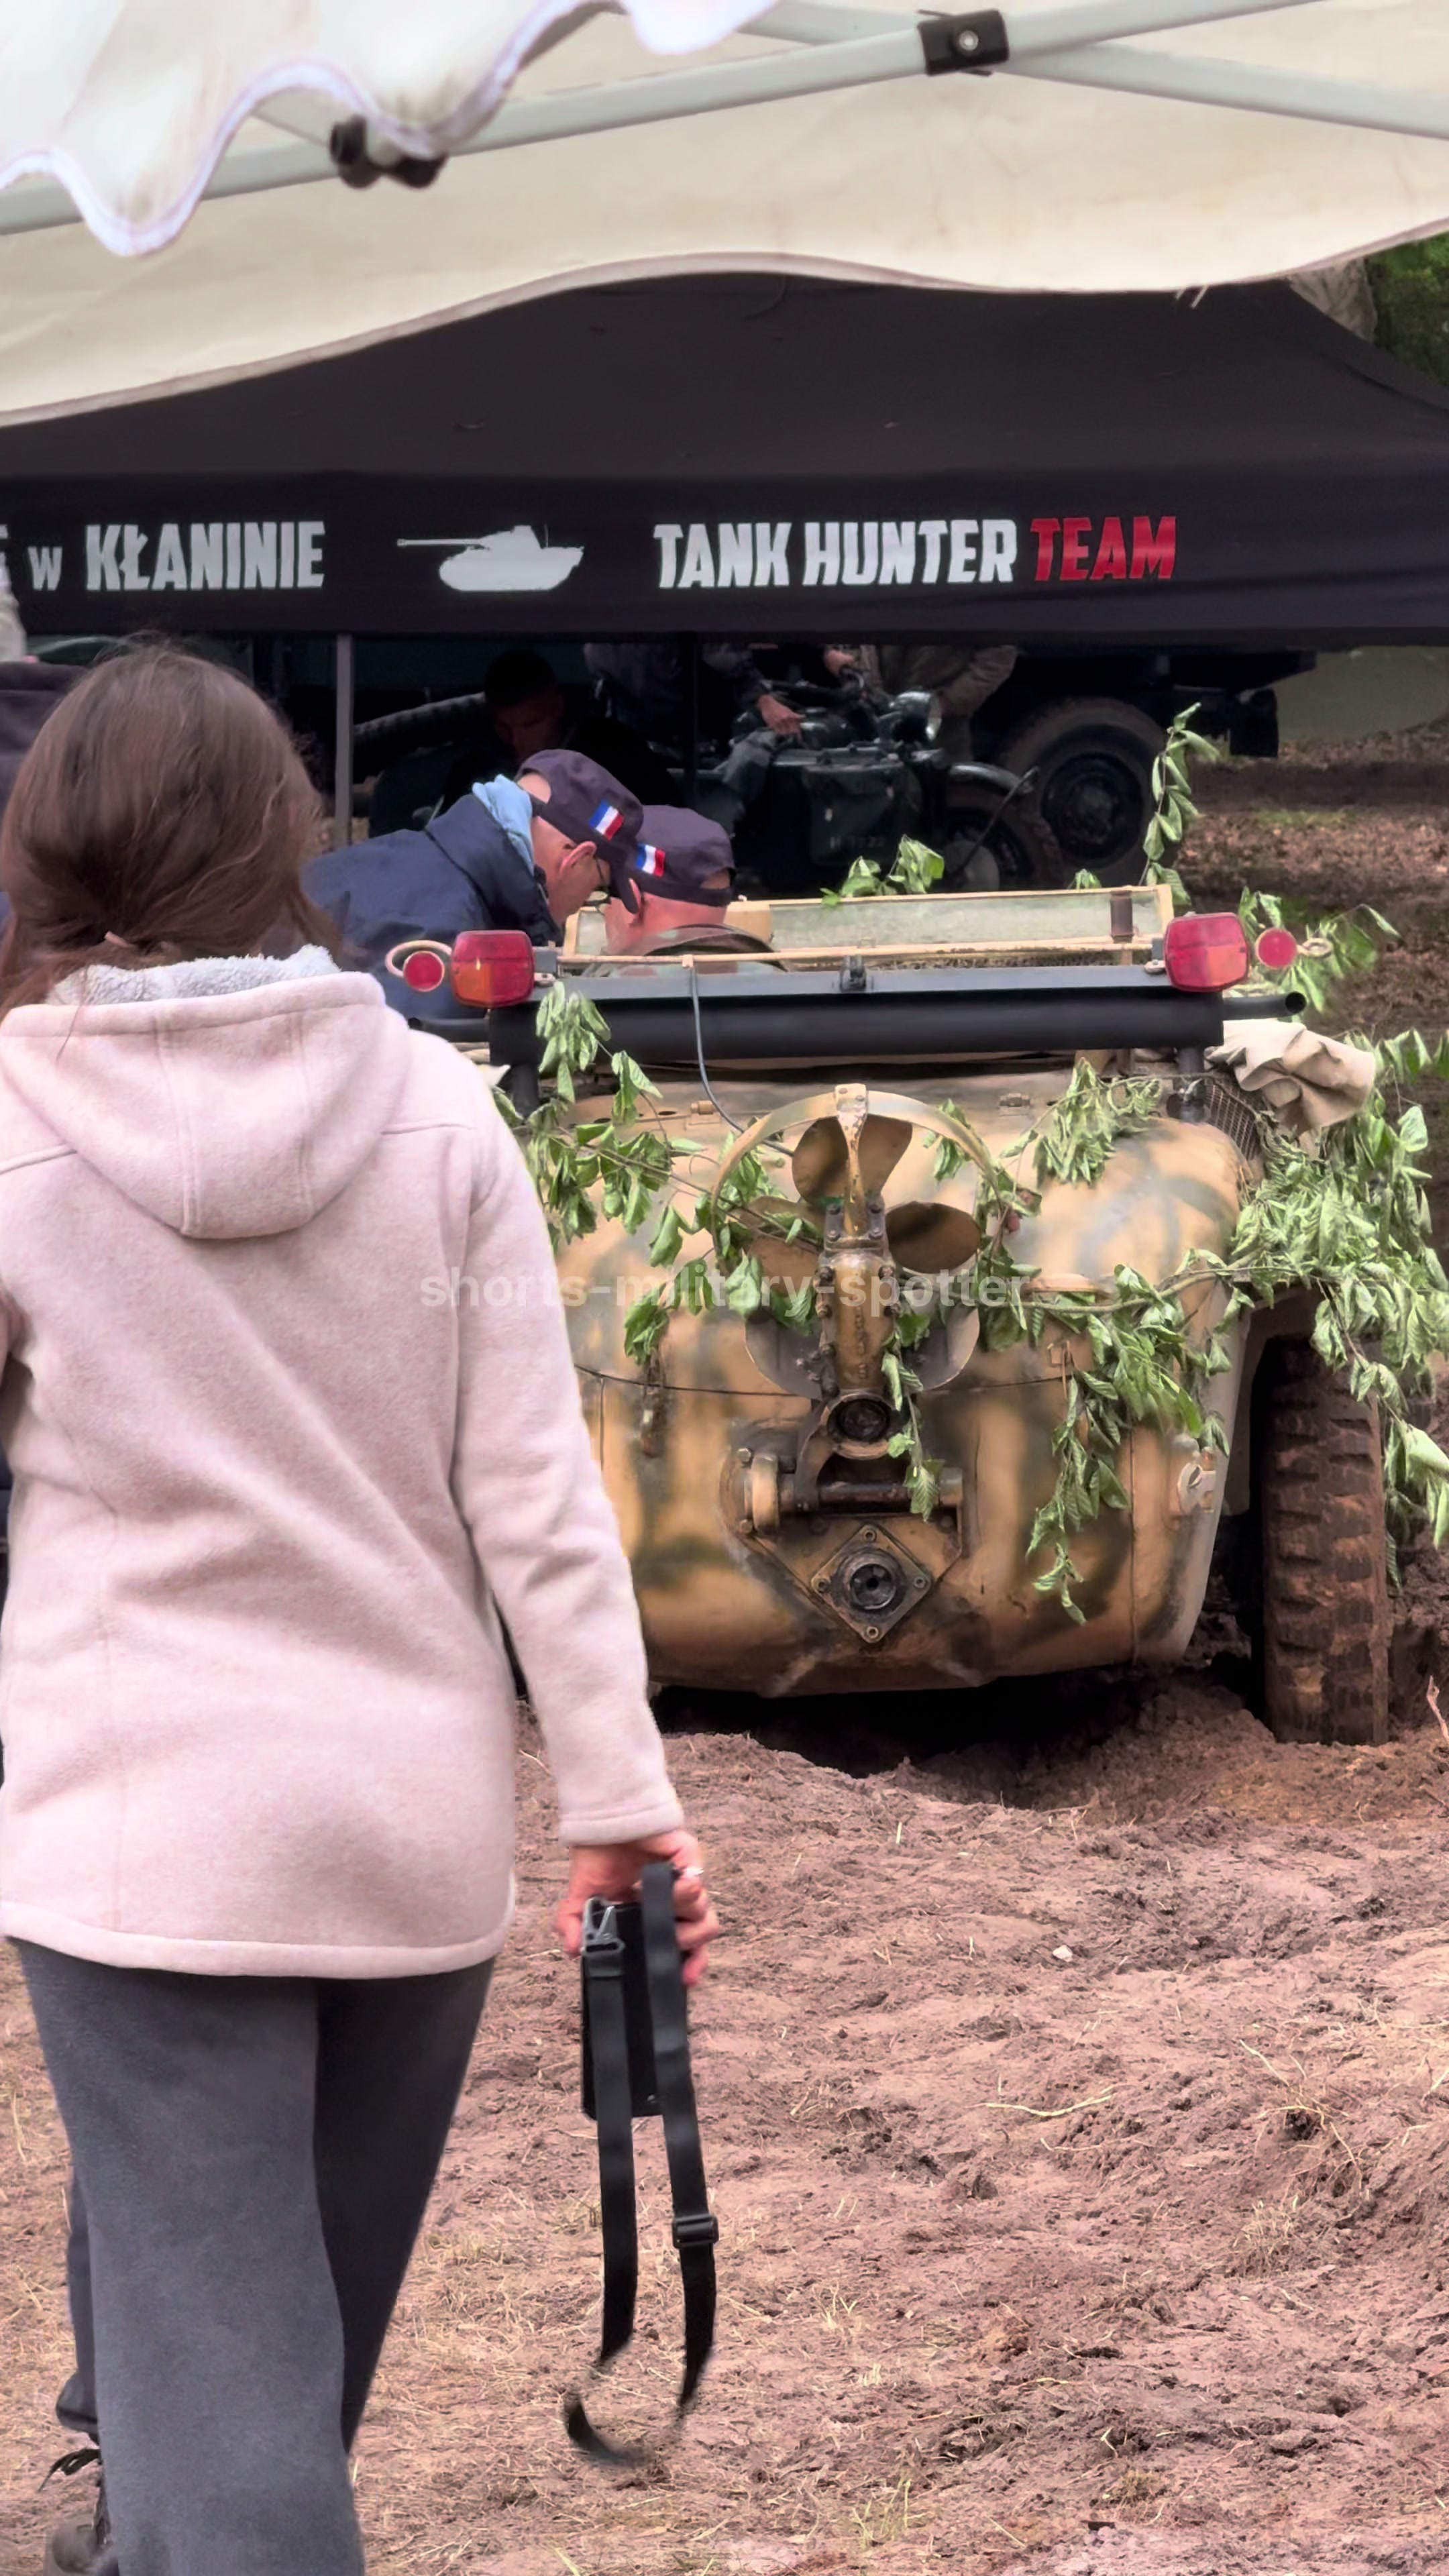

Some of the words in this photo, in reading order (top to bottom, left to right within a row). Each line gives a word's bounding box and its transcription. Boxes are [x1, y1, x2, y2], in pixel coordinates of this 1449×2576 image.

[86, 521, 325, 591] KŁANINIE
[653, 522, 792, 589] TANK
[802, 519, 1018, 586] HUNTER
[1030, 516, 1177, 582] TEAM
